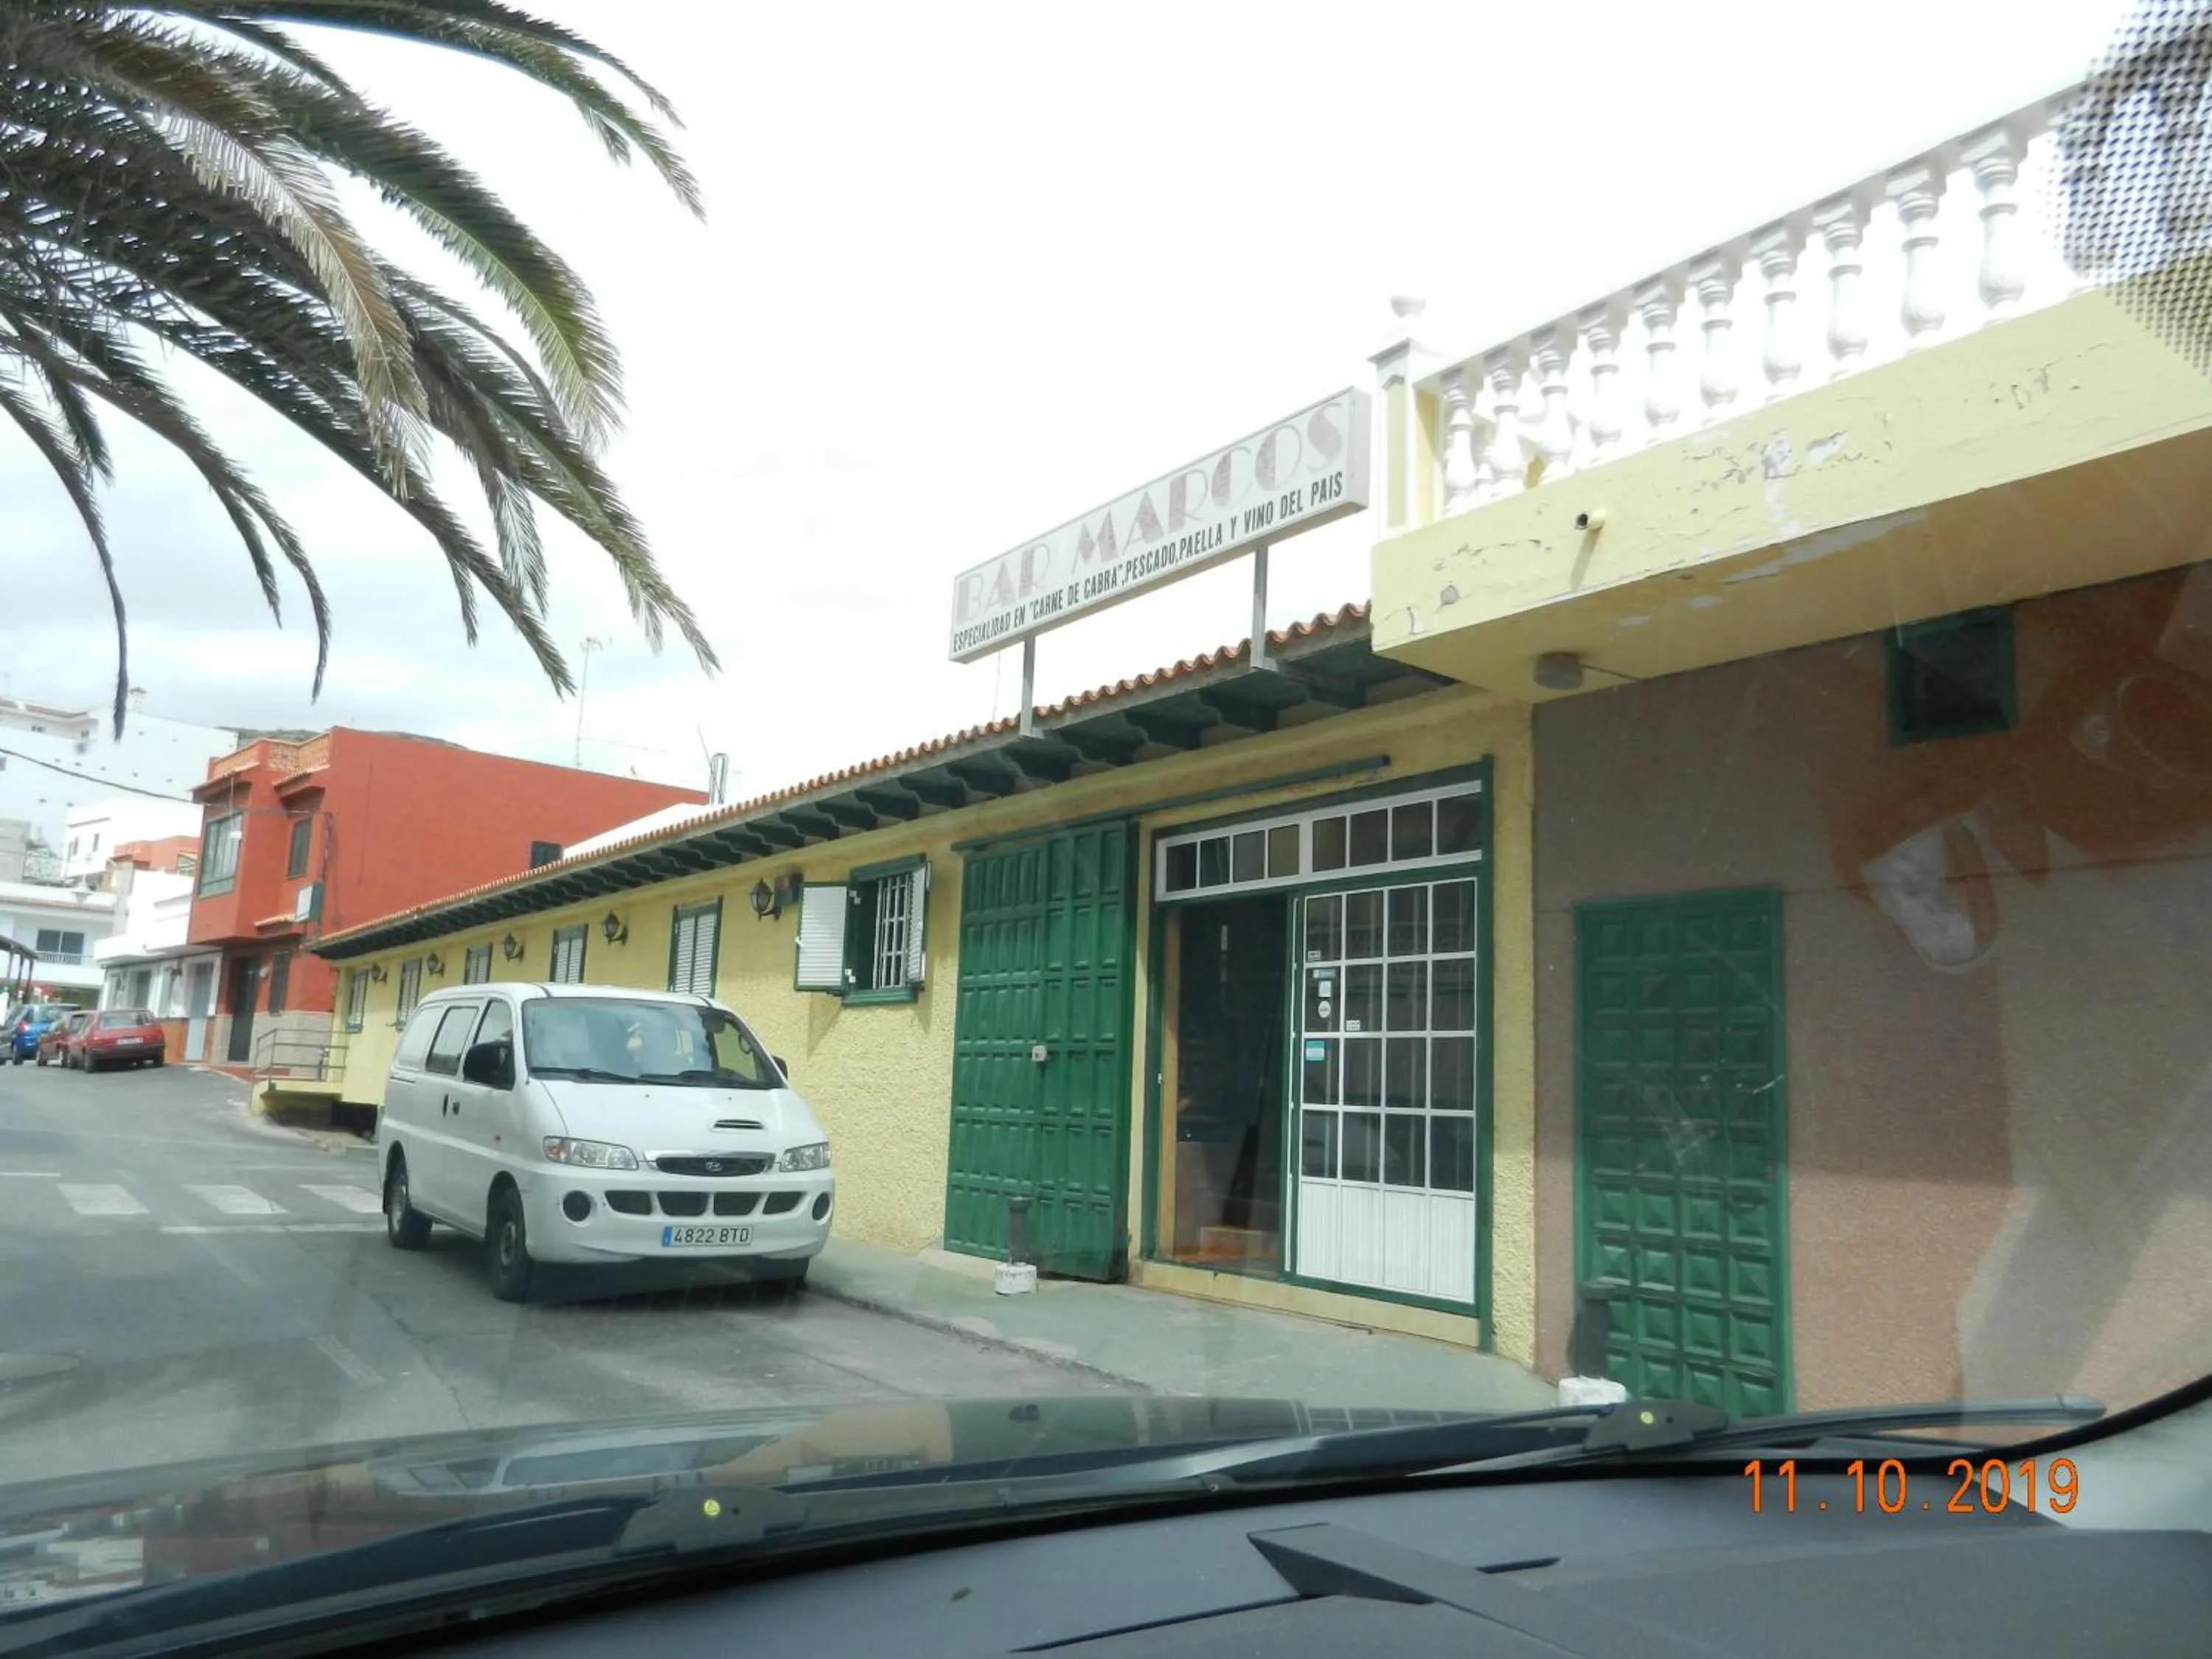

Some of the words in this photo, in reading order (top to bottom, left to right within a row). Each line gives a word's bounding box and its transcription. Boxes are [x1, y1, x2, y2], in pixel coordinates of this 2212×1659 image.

[953, 611, 1011, 653] ESPECIALIDAD
[1014, 605, 1026, 627] EN
[1067, 582, 1080, 607] DE
[1230, 514, 1238, 540] Y
[1244, 500, 1273, 534] VINO
[1279, 488, 1303, 520] DEL
[1310, 471, 1343, 507] PAIS
[957, 542, 1051, 625] BAR
[1071, 402, 1344, 577] MARCOS
[674, 1228, 714, 1243] 4822
[720, 1228, 749, 1243] BTD
